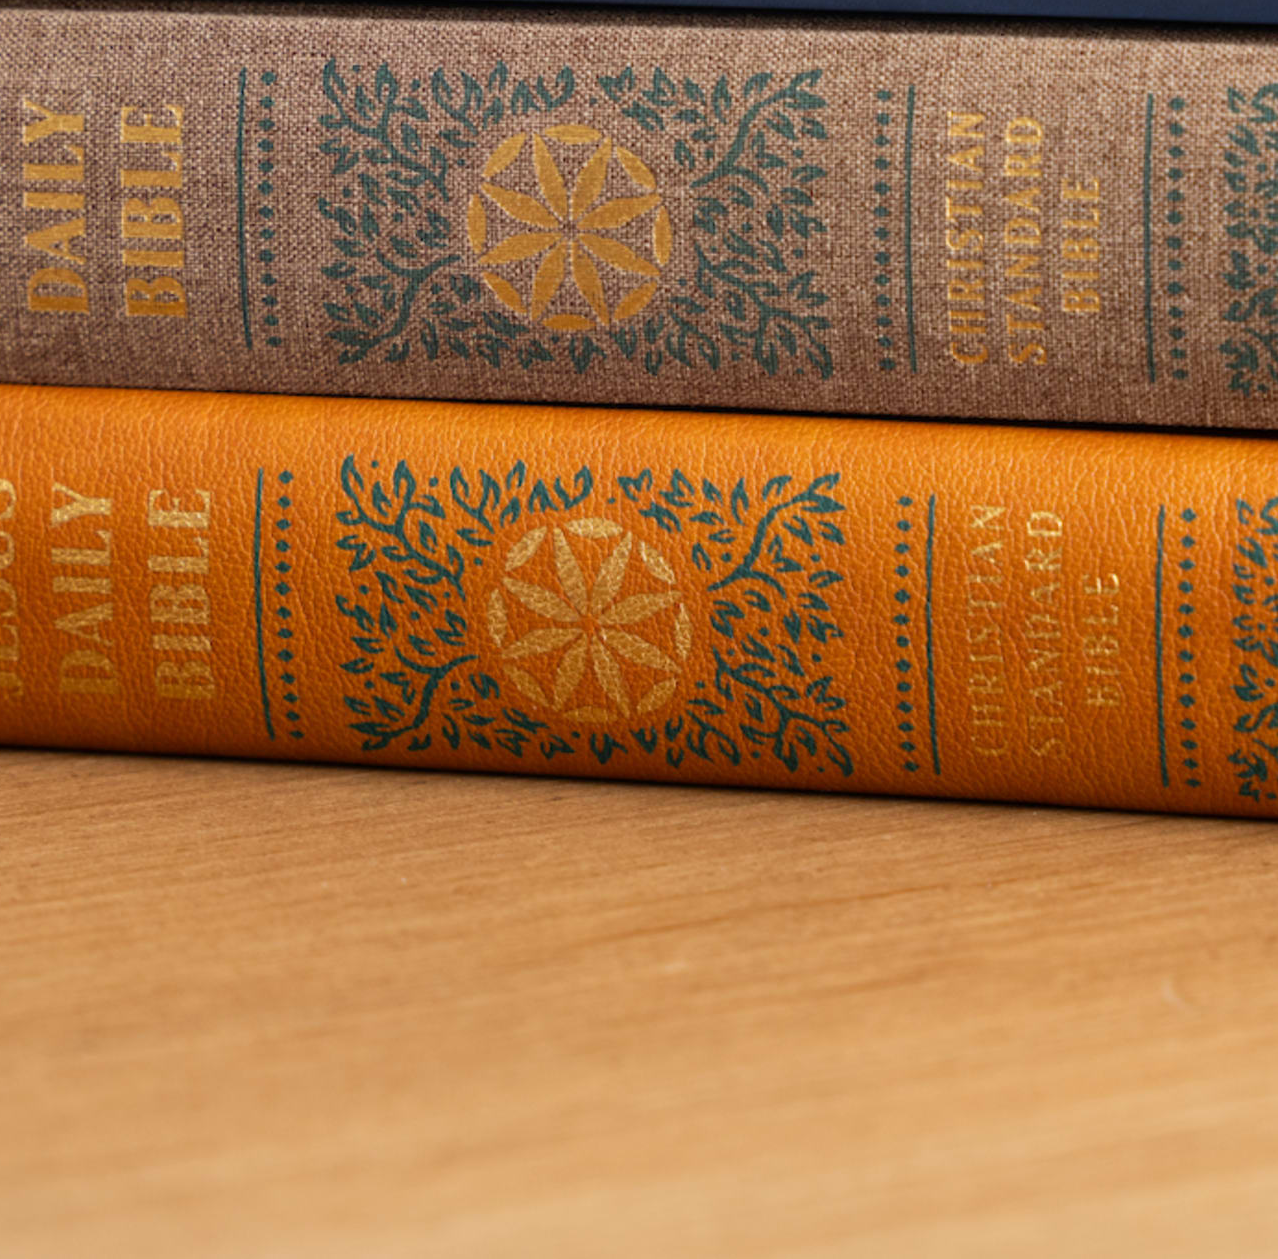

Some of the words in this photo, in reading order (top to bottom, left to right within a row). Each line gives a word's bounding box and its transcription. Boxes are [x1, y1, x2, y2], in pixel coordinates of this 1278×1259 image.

[22, 99, 90, 315] DAILY
[120, 104, 188, 319] BIBLE
[945, 111, 989, 365] CHRISTIAN
[1004, 116, 1047, 366] STANDARD
[1062, 176, 1101, 313] BIBLE
[51, 483, 121, 695] DAILY
[147, 487, 218, 701] BIBLE
[1026, 510, 1064, 757] STANDARD
[1084, 572, 1121, 709] BIBLE
